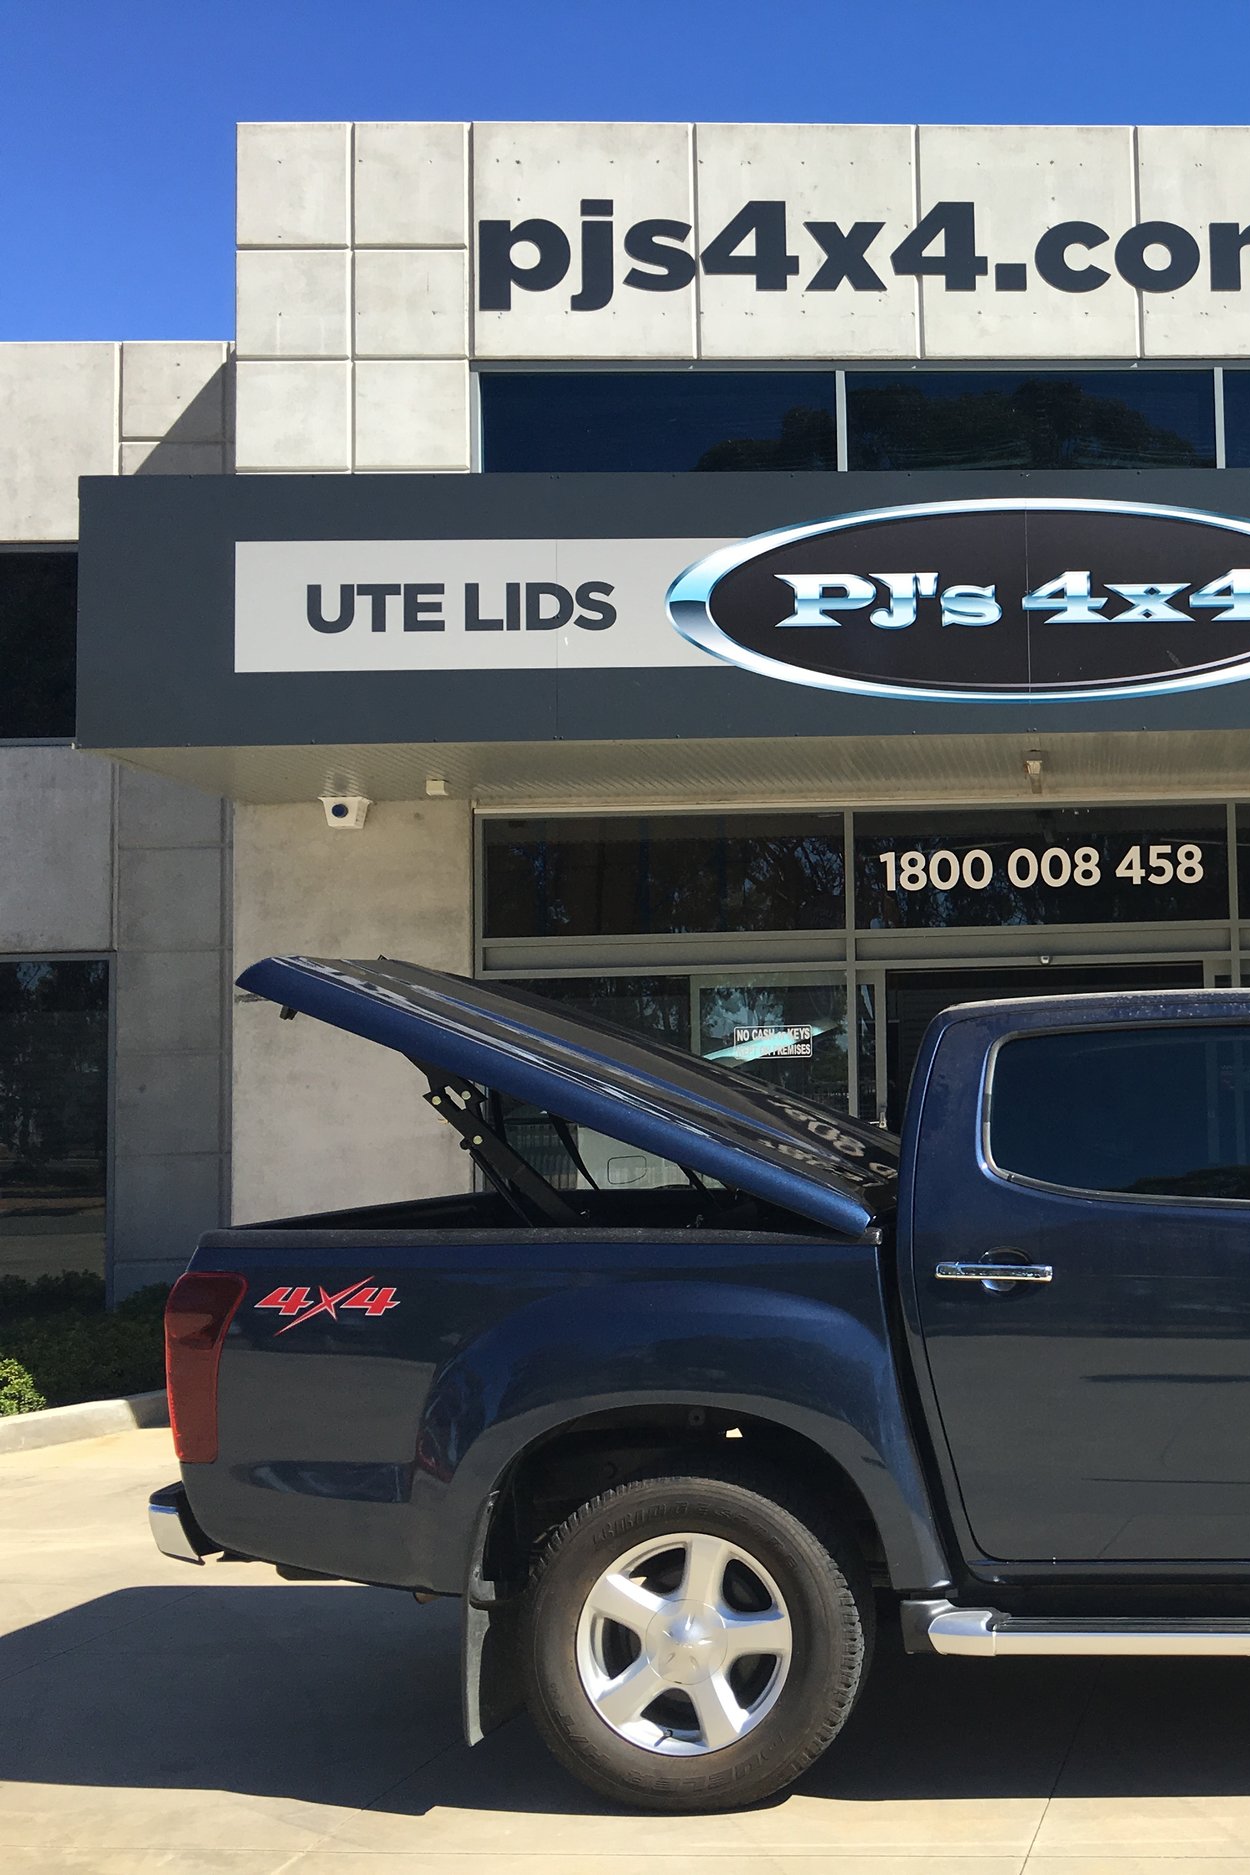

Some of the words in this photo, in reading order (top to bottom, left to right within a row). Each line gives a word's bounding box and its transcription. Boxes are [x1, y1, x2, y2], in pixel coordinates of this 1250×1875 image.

[306, 583, 446, 634] UTE
[464, 581, 617, 631] LIDS
[773, 572, 1003, 629] PJ's
[879, 849, 993, 891] 1800
[1007, 846, 1101, 889] 008
[1115, 844, 1204, 885] 458
[736, 1028, 750, 1042] NO
[787, 1027, 811, 1041] KEYS
